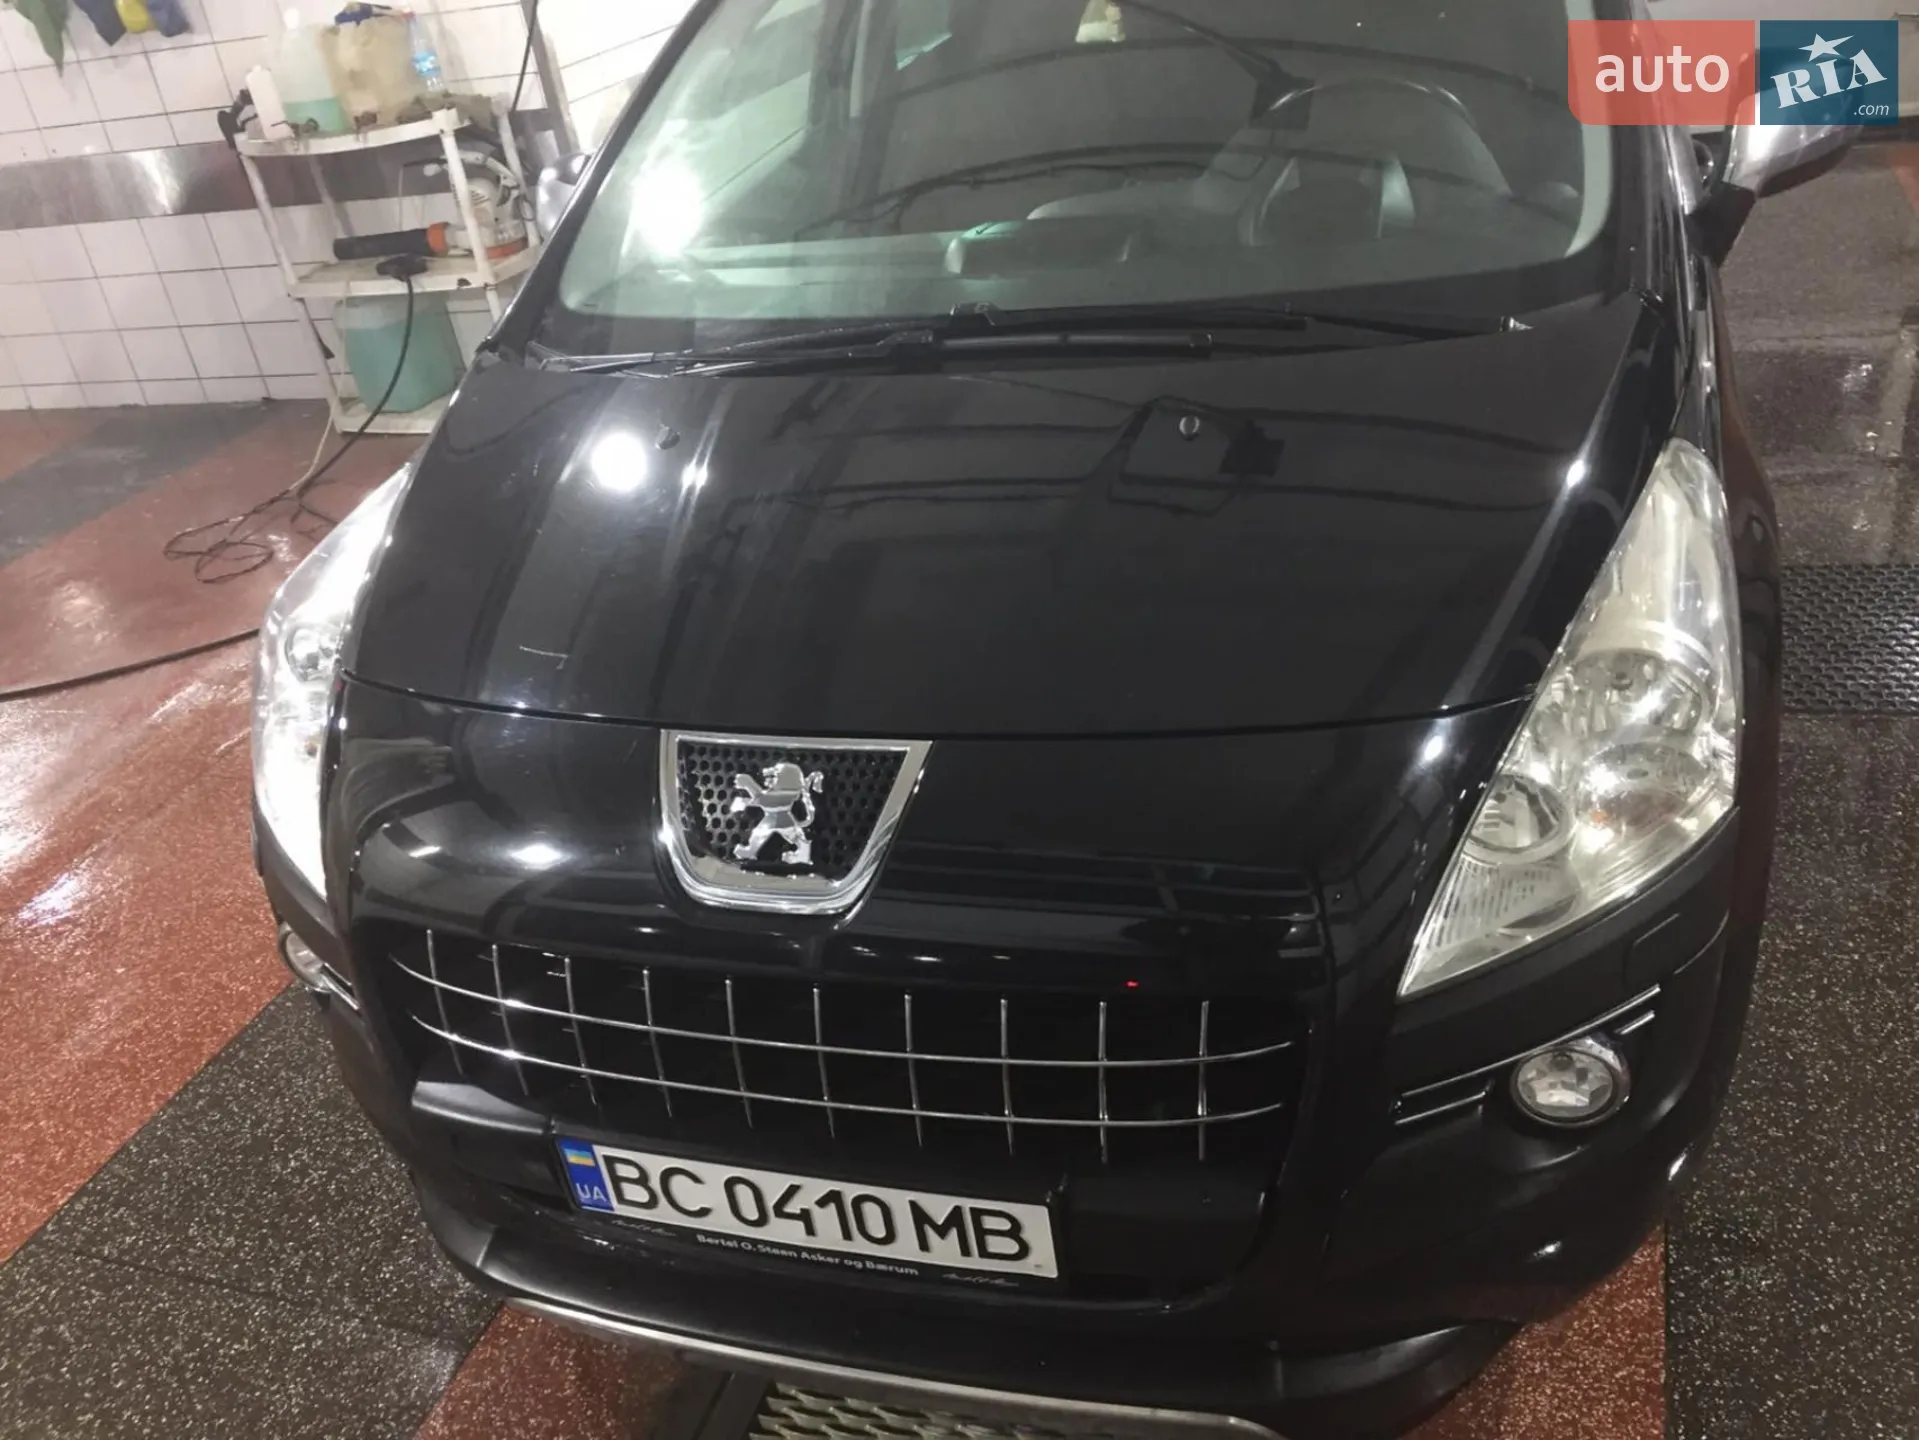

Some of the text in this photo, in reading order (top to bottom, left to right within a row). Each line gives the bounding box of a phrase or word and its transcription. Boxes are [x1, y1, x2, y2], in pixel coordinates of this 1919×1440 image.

[576, 1182, 606, 1202] UA
[602, 1154, 1032, 1261] BC 0410 MB
[696, 1233, 739, 1249] Bertel
[758, 1244, 798, 1259] Steen
[800, 1251, 841, 1265] Asker
[843, 1258, 864, 1270] og
[865, 1259, 920, 1276] Bærum
